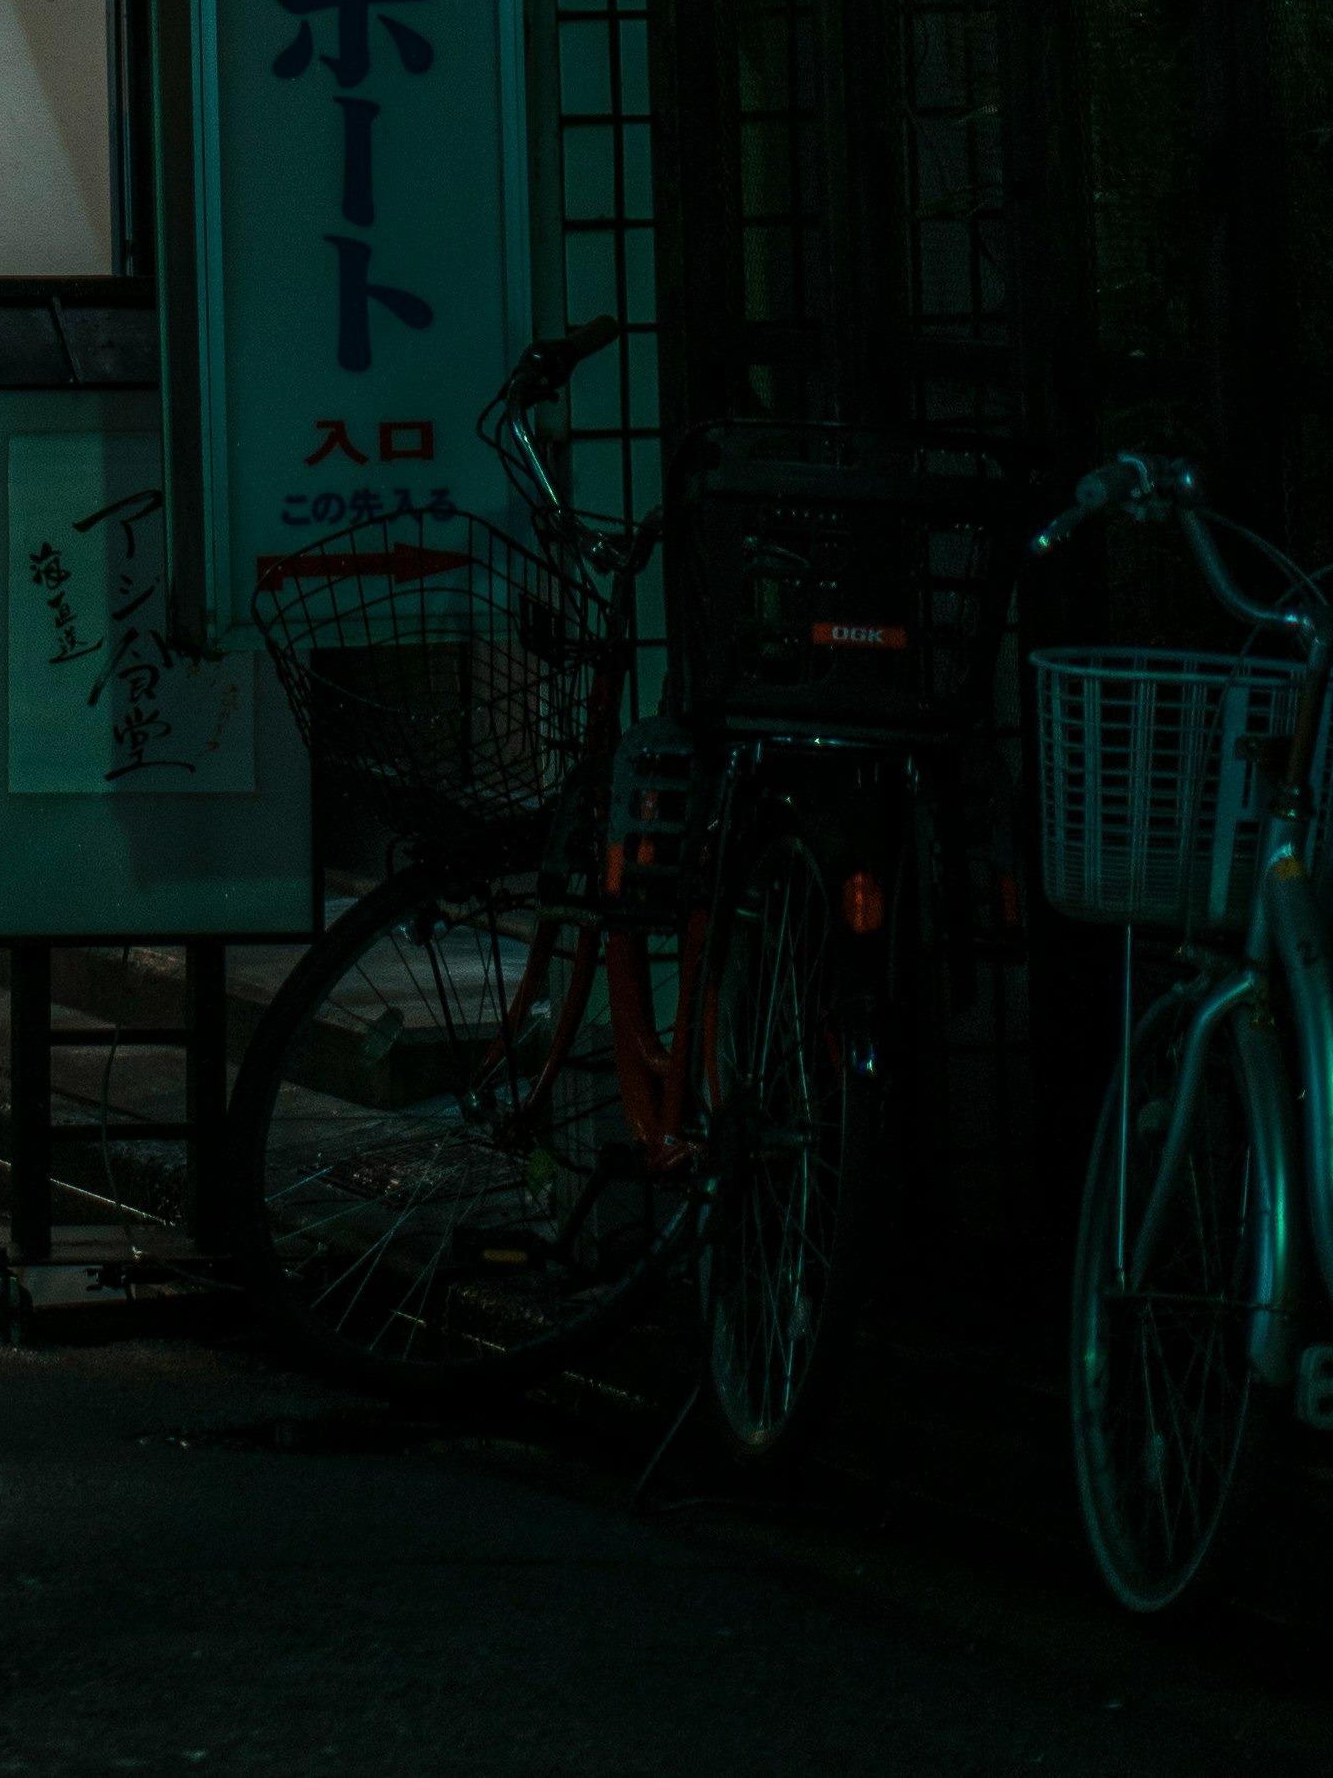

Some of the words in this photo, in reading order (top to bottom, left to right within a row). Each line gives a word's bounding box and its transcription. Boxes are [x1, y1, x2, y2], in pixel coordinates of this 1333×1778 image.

[304, 420, 434, 466] 入口
[281, 487, 457, 526] この先入る
